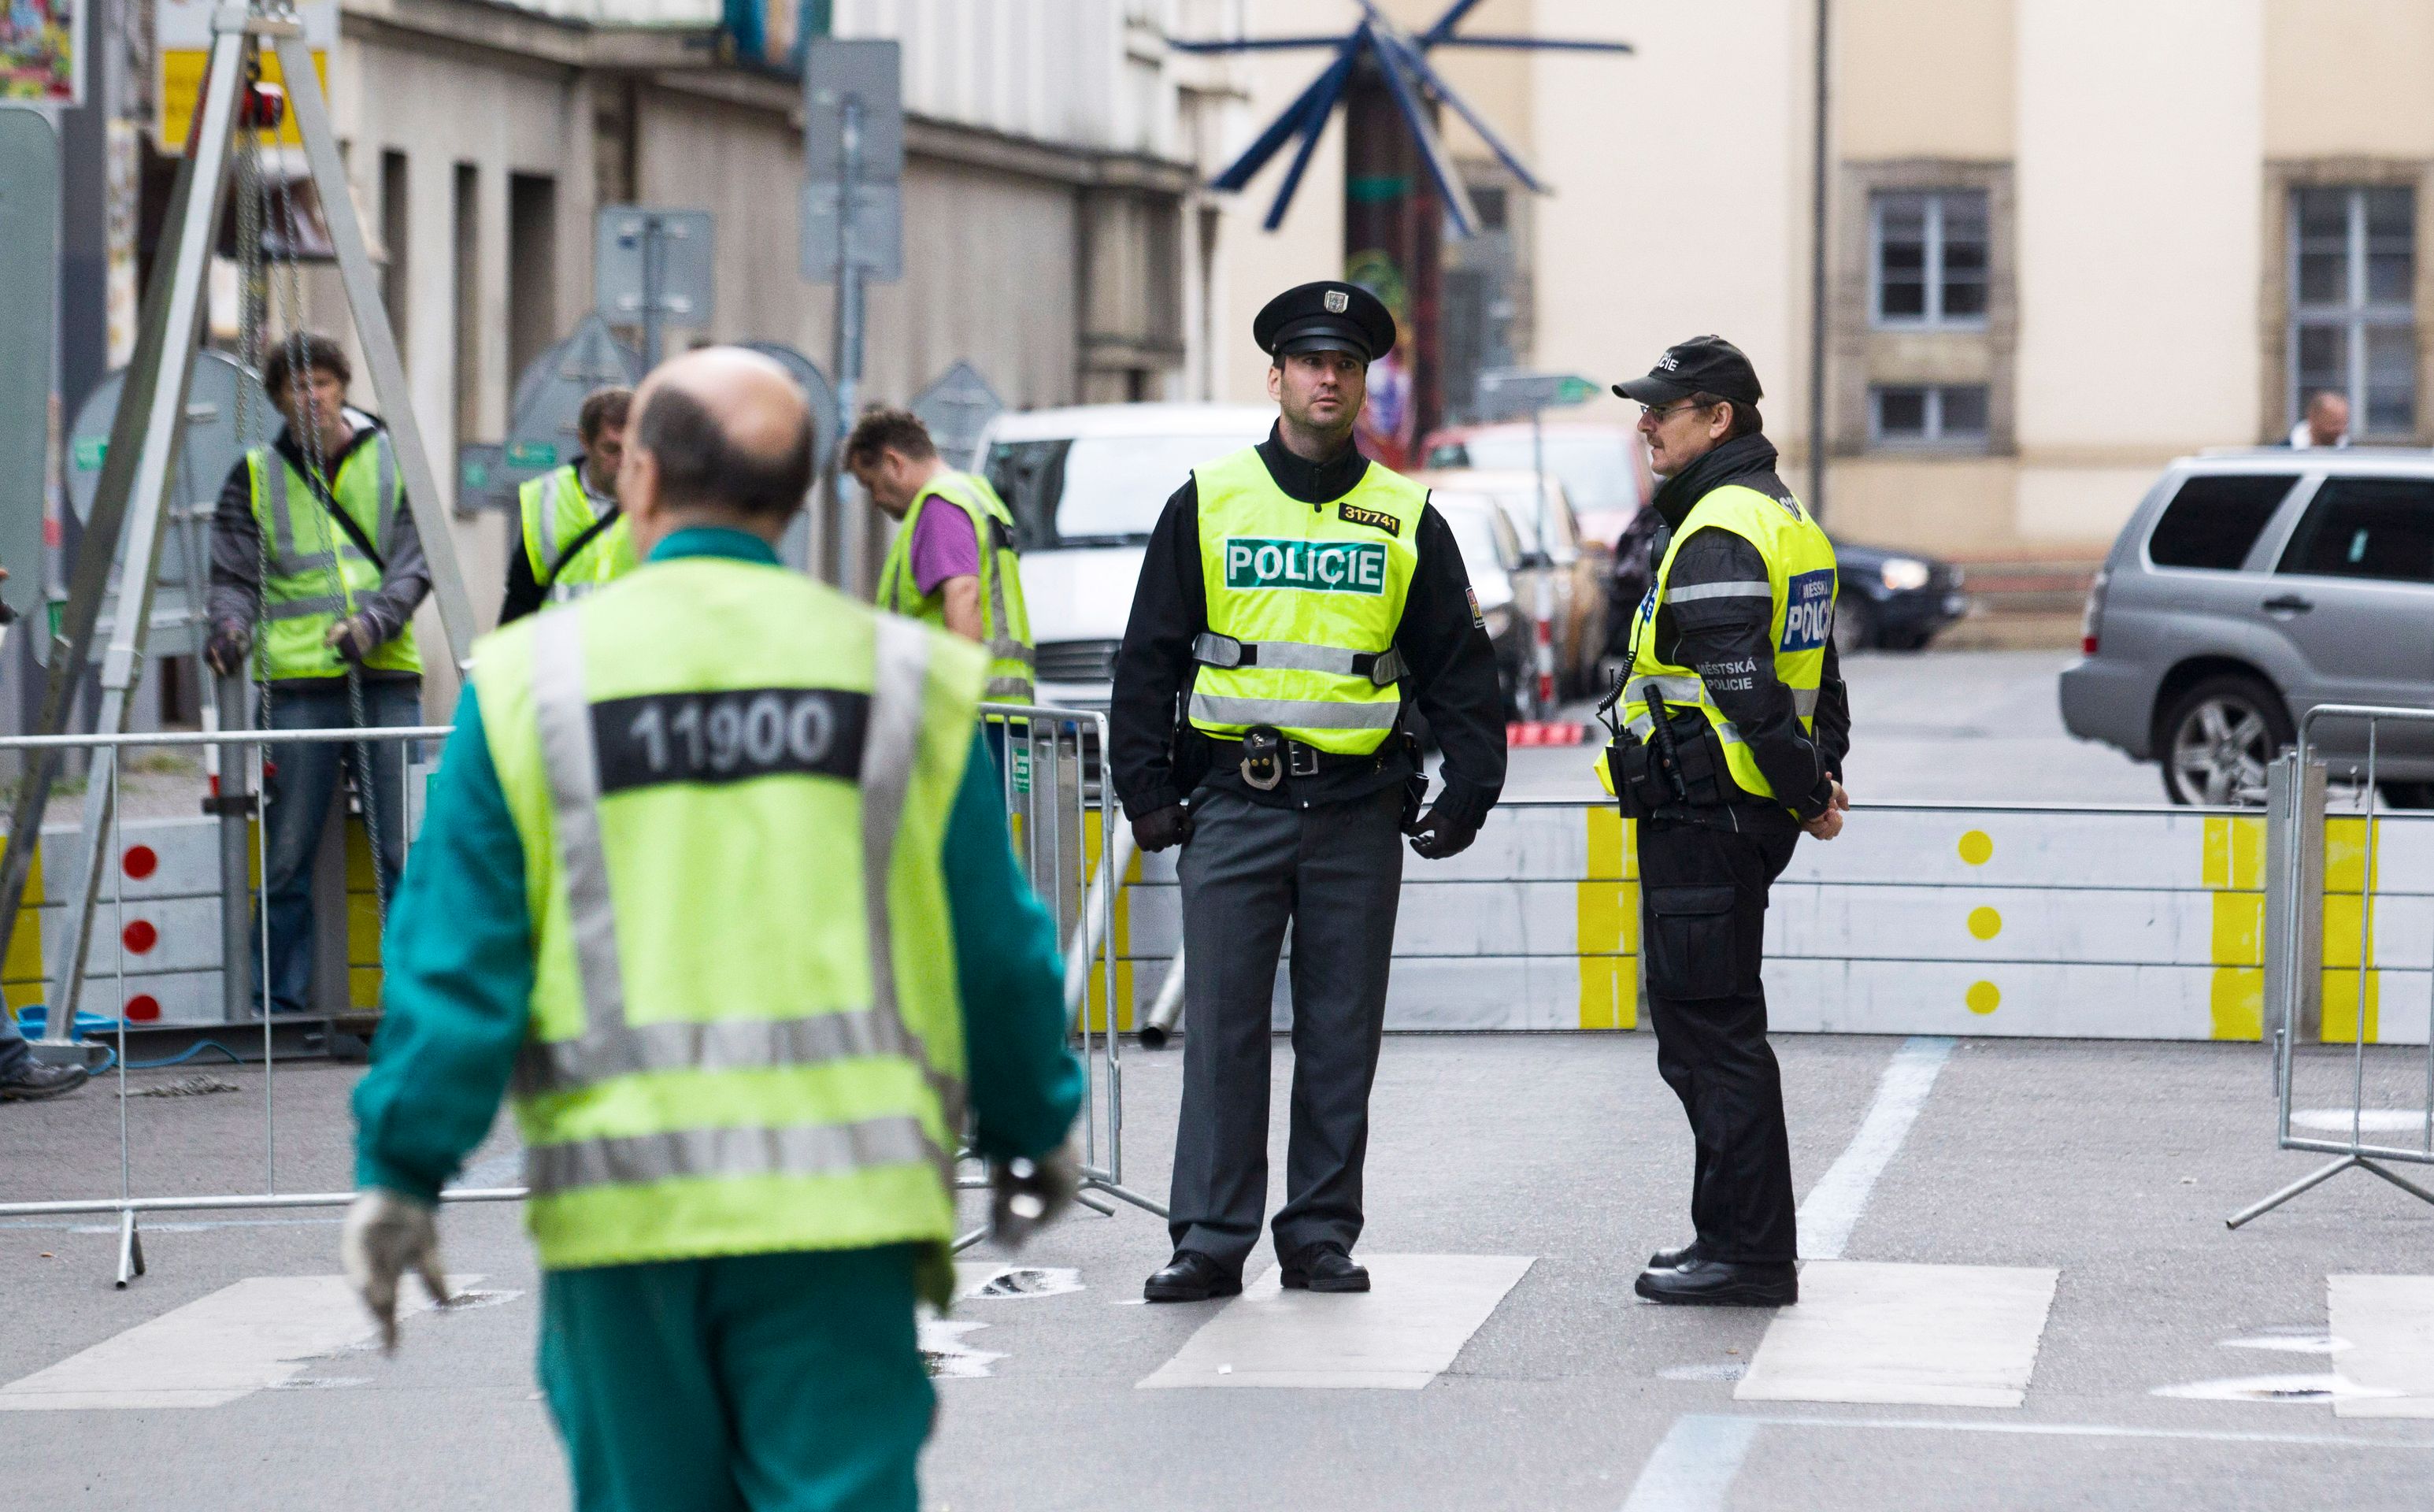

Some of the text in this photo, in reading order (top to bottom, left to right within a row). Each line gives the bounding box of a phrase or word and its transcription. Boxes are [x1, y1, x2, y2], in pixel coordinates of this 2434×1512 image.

[1345, 506, 1396, 531] 317741
[1229, 545, 1383, 586] POLICIE
[1695, 657, 1758, 676] MĚSTSKÁ
[1706, 677, 1754, 691] POLICIE
[629, 694, 832, 772] 11900
